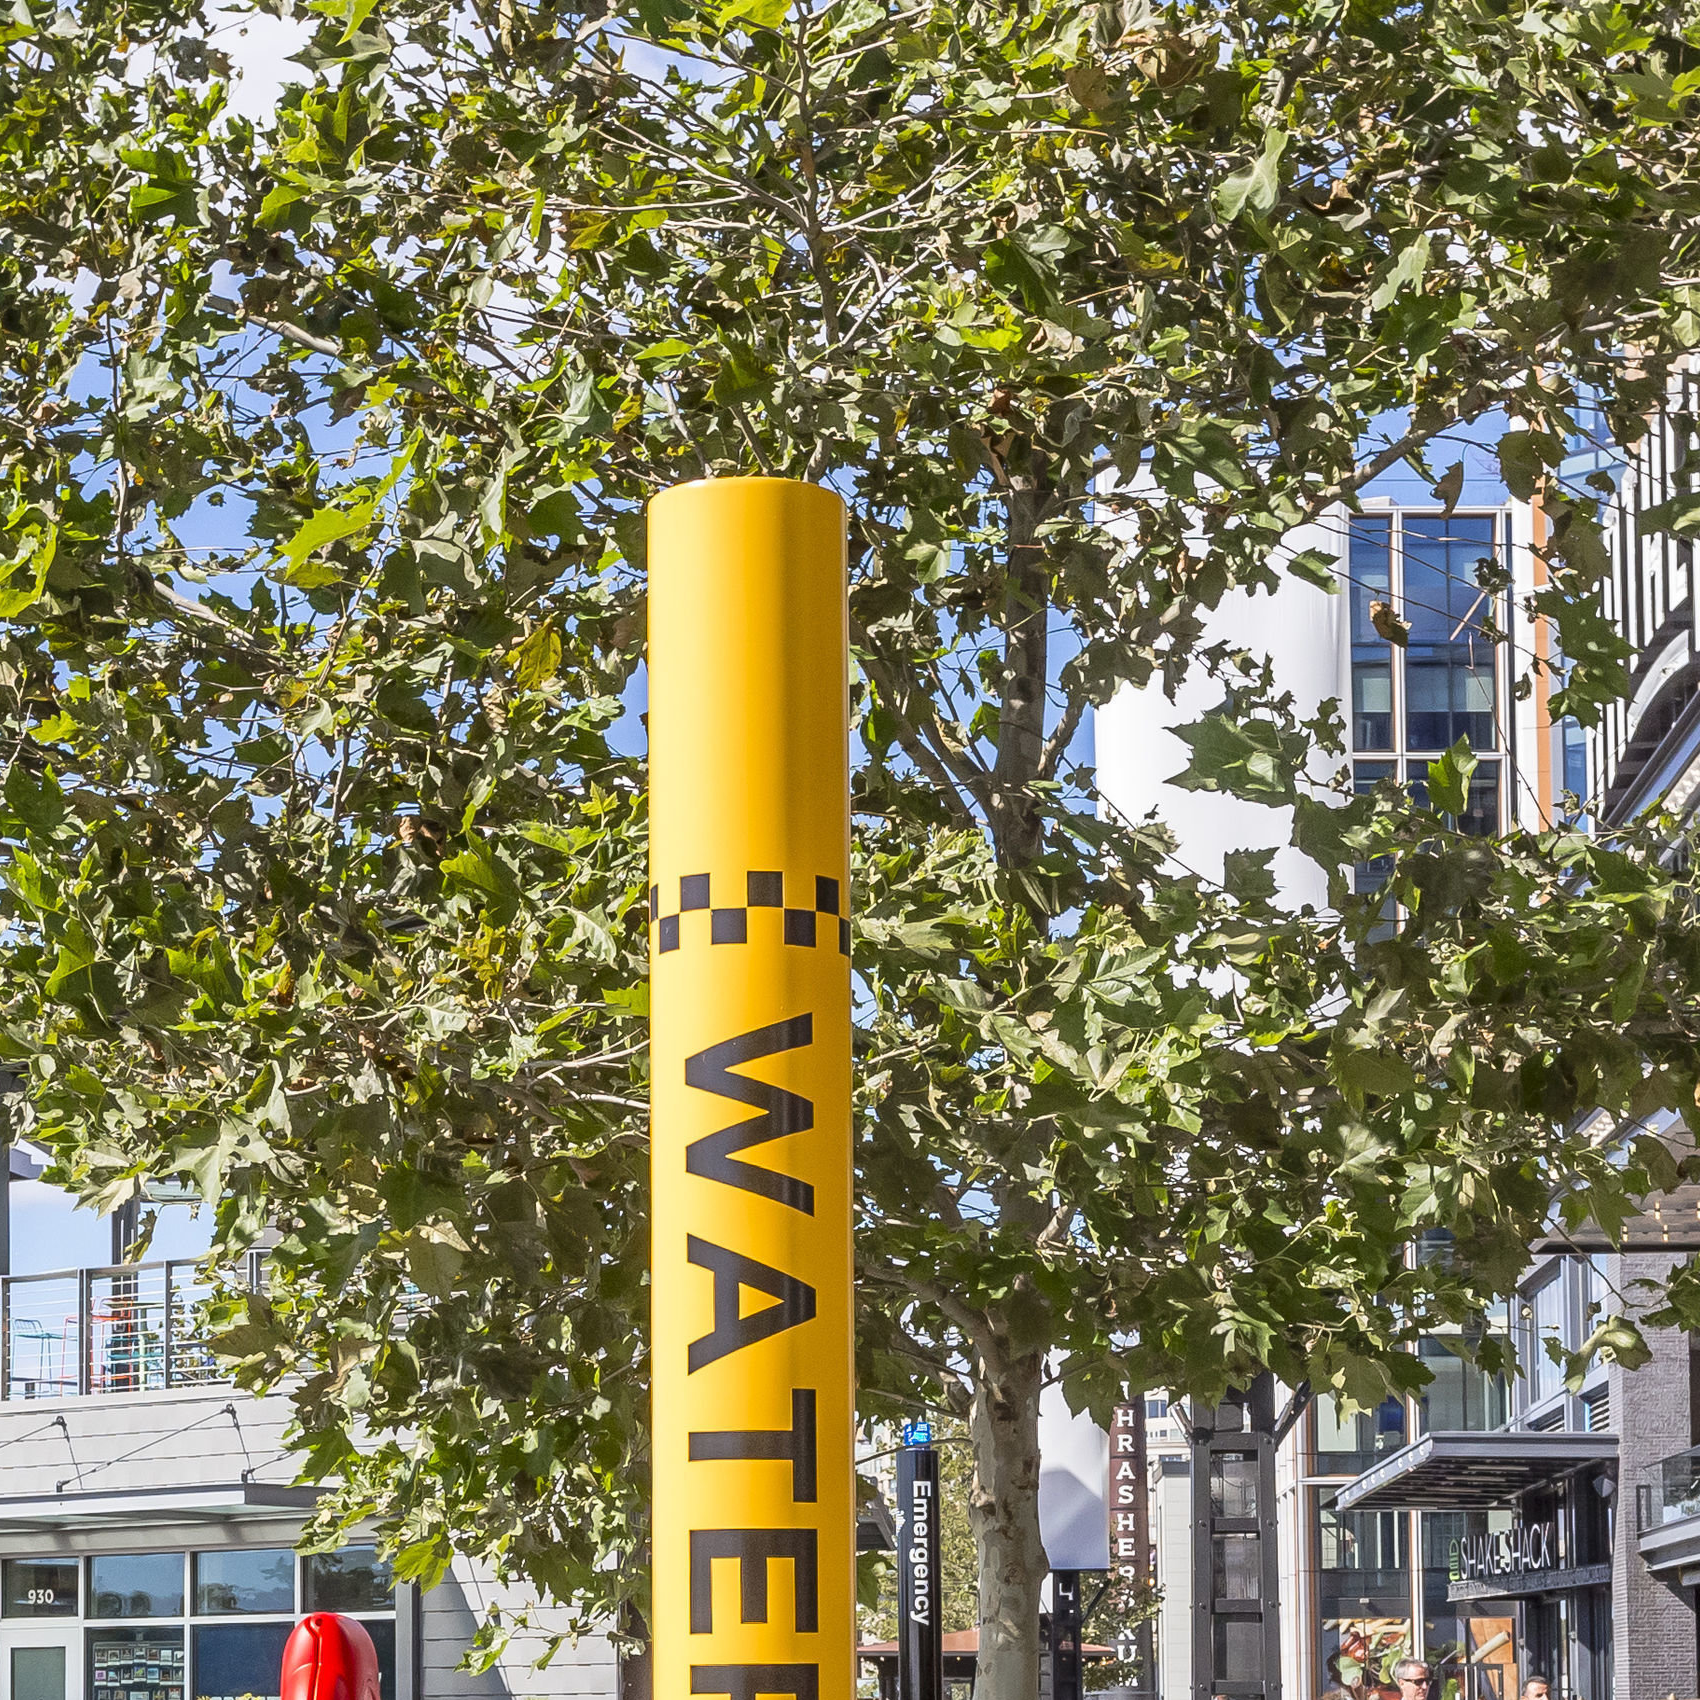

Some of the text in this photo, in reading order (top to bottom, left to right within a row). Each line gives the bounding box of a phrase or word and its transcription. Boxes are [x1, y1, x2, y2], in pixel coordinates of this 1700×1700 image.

[909, 1480, 931, 1626] Emergency
[1460, 1522, 1551, 1580] SHAKE SHACK
[28, 1589, 54, 1604] 930
